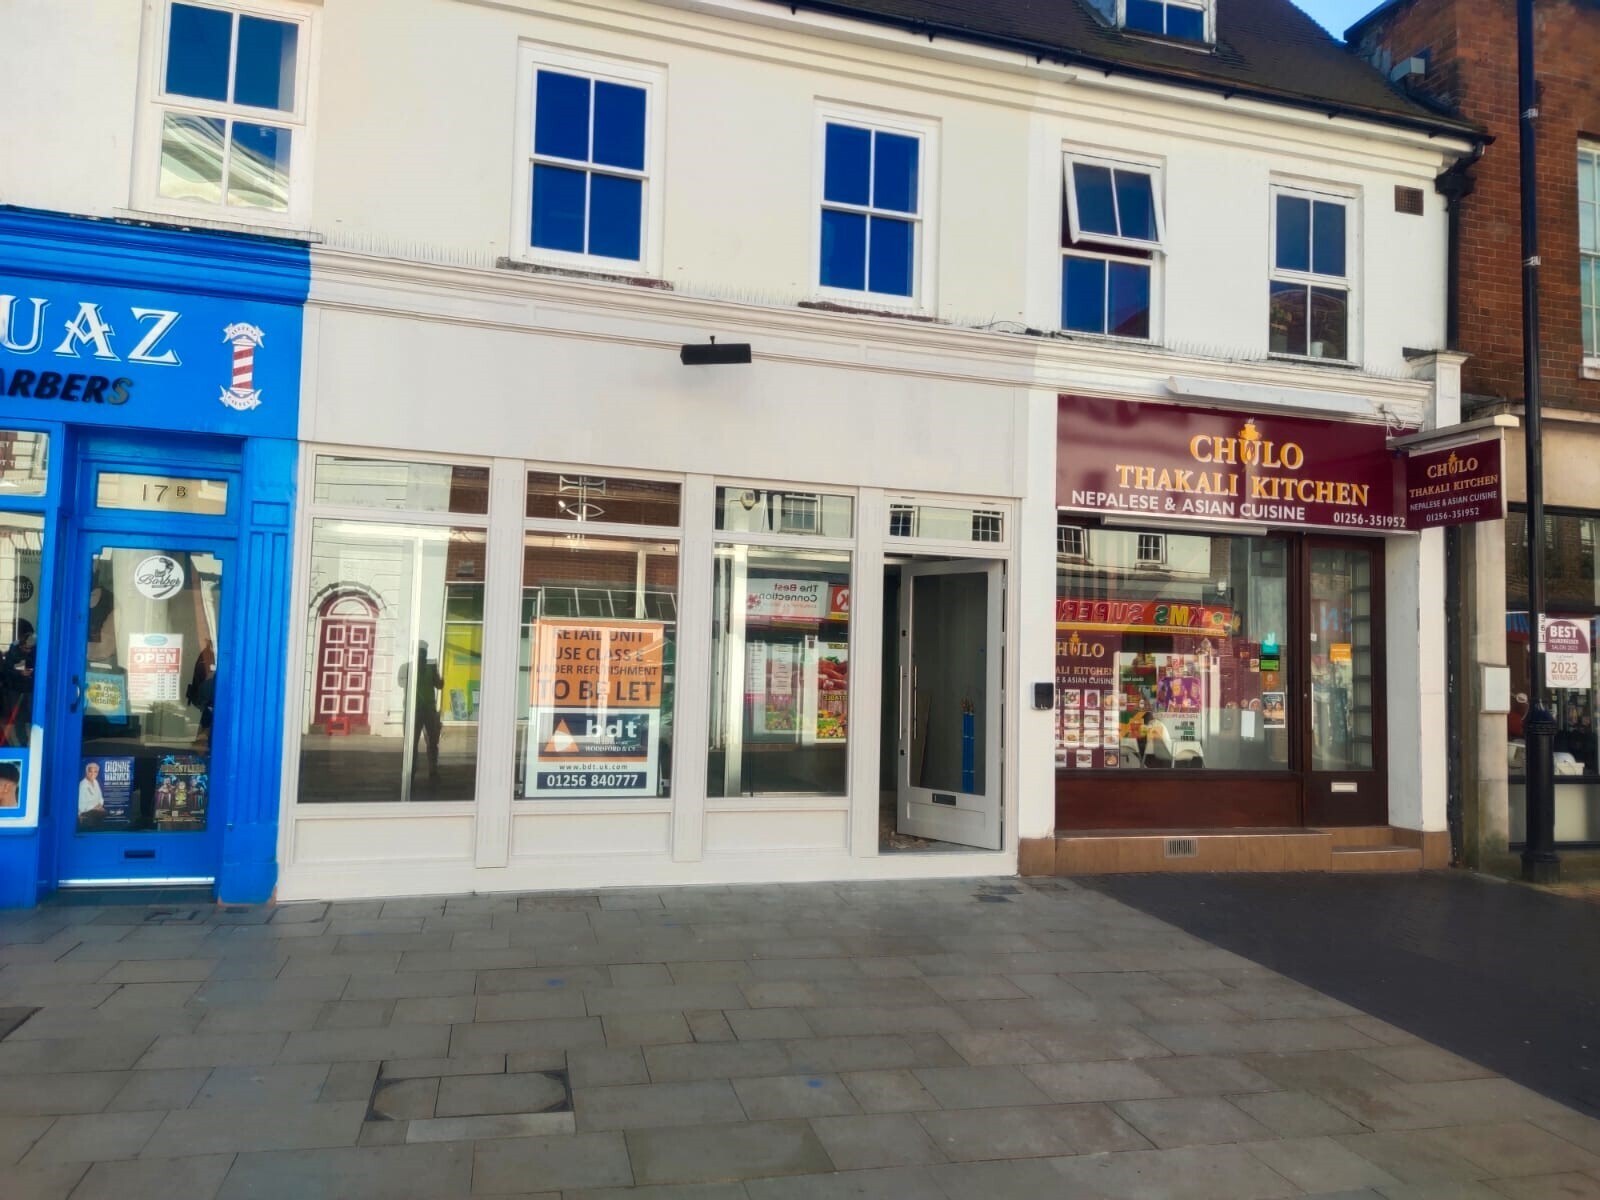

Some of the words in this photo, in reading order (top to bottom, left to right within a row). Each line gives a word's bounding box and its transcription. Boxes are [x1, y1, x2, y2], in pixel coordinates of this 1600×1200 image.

[1190, 434, 1304, 470] CHULO
[1427, 457, 1479, 479] CHULO
[142, 483, 168, 502] 17
[176, 486, 188, 498] B
[1115, 464, 1239, 497] THAKALI
[1251, 476, 1370, 507] KITCHEN
[1409, 482, 1450, 498] THAKALI
[1453, 474, 1498, 491] KITCHEN
[1071, 490, 1159, 510] NEPALESE
[1164, 496, 1176, 511] &
[1182, 498, 1235, 515] ASIAN
[1240, 503, 1306, 521] CUISINE
[1409, 501, 1441, 511] NEPALESE
[1447, 495, 1468, 506] ASIAN
[1469, 491, 1497, 502] CUISINE
[1333, 512, 1406, 528] 01256-351952
[1426, 507, 1480, 522] 01256-351952
[1550, 625, 1578, 638] BEST
[134, 652, 177, 665] OPEN
[1551, 662, 1578, 674] 2023
[576, 664, 659, 676] REFUISHMENT
[615, 681, 656, 702] LET
[586, 719, 637, 738] bdt
[559, 763, 629, 771] www.bdt.uk.com
[546, 774, 588, 788] 01256
[590, 774, 639, 788] 840777
